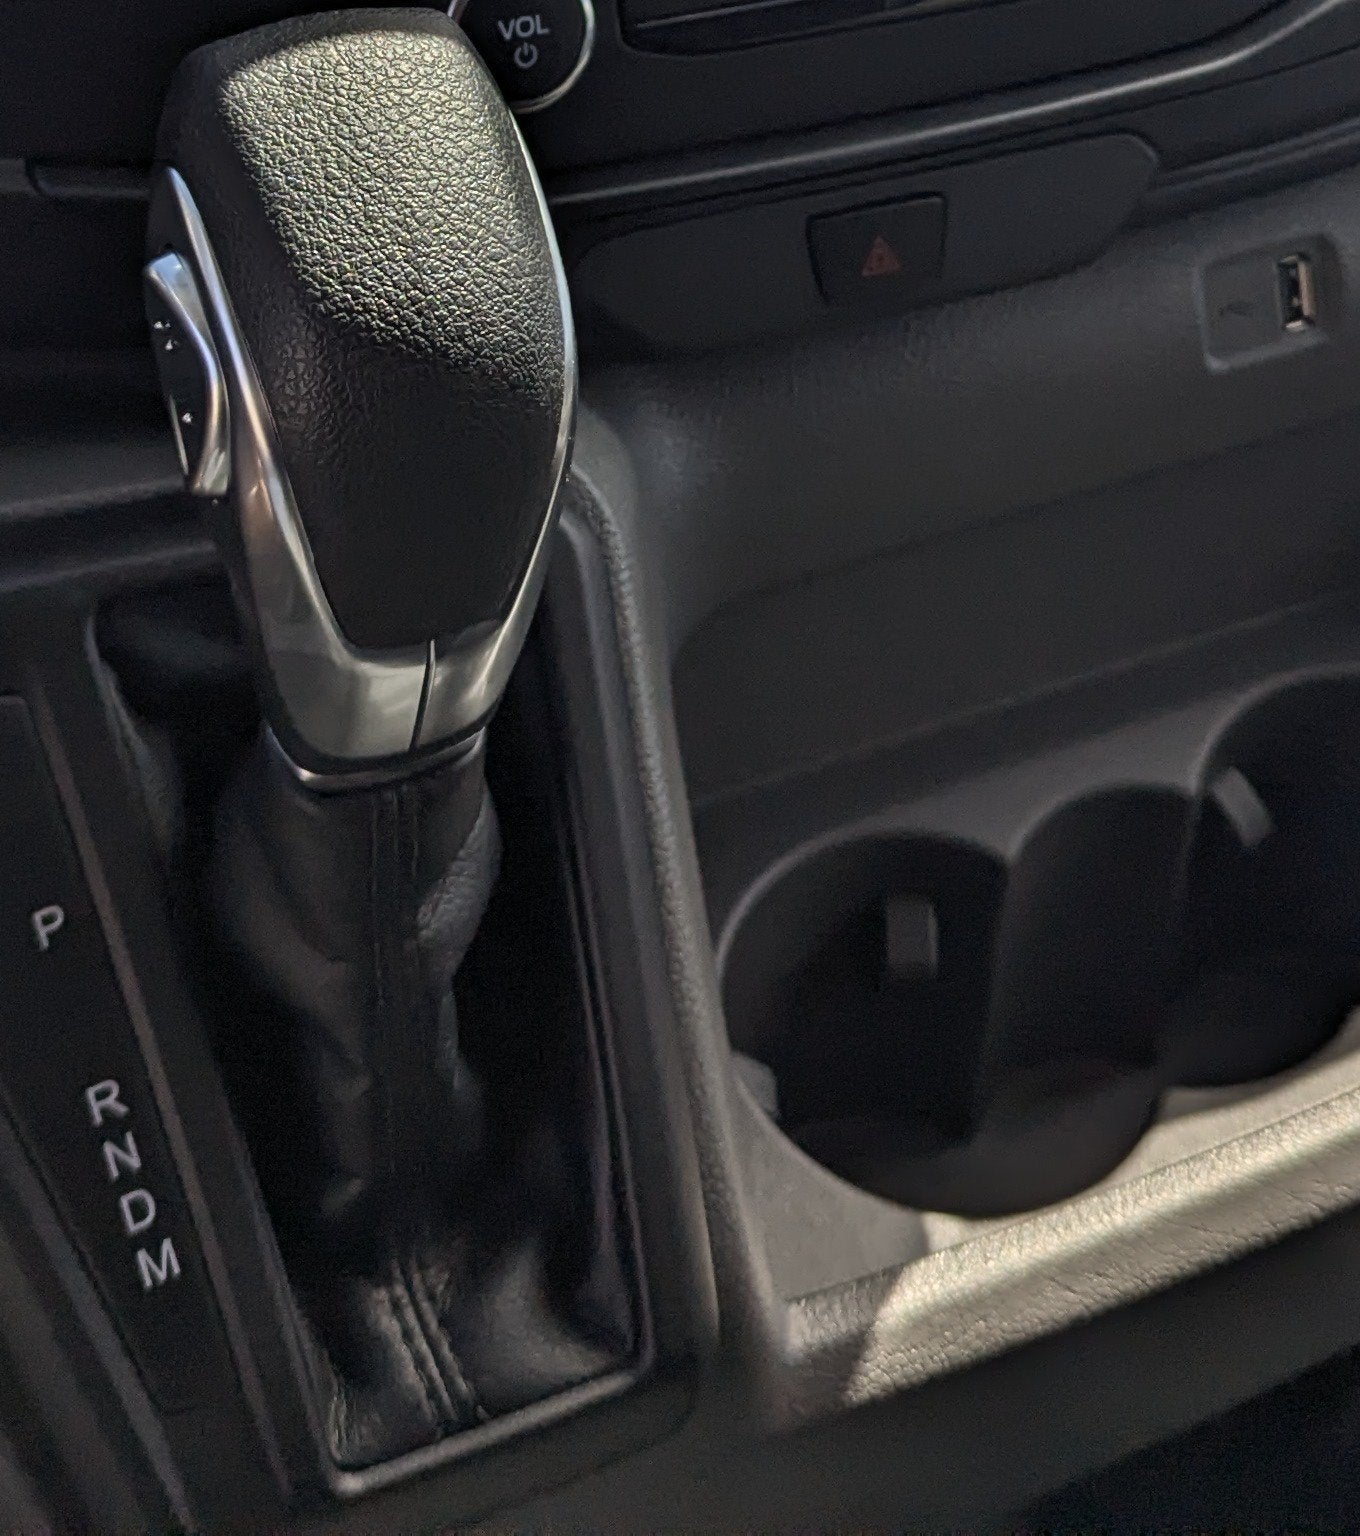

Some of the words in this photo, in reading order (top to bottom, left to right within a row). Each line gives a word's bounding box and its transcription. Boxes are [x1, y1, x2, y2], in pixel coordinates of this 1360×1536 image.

[497, 14, 551, 40] VOL
[31, 904, 65, 951] P
[84, 1079, 130, 1127] R
[101, 1131, 142, 1181] N
[118, 1188, 156, 1235] D
[136, 1237, 181, 1290] M
